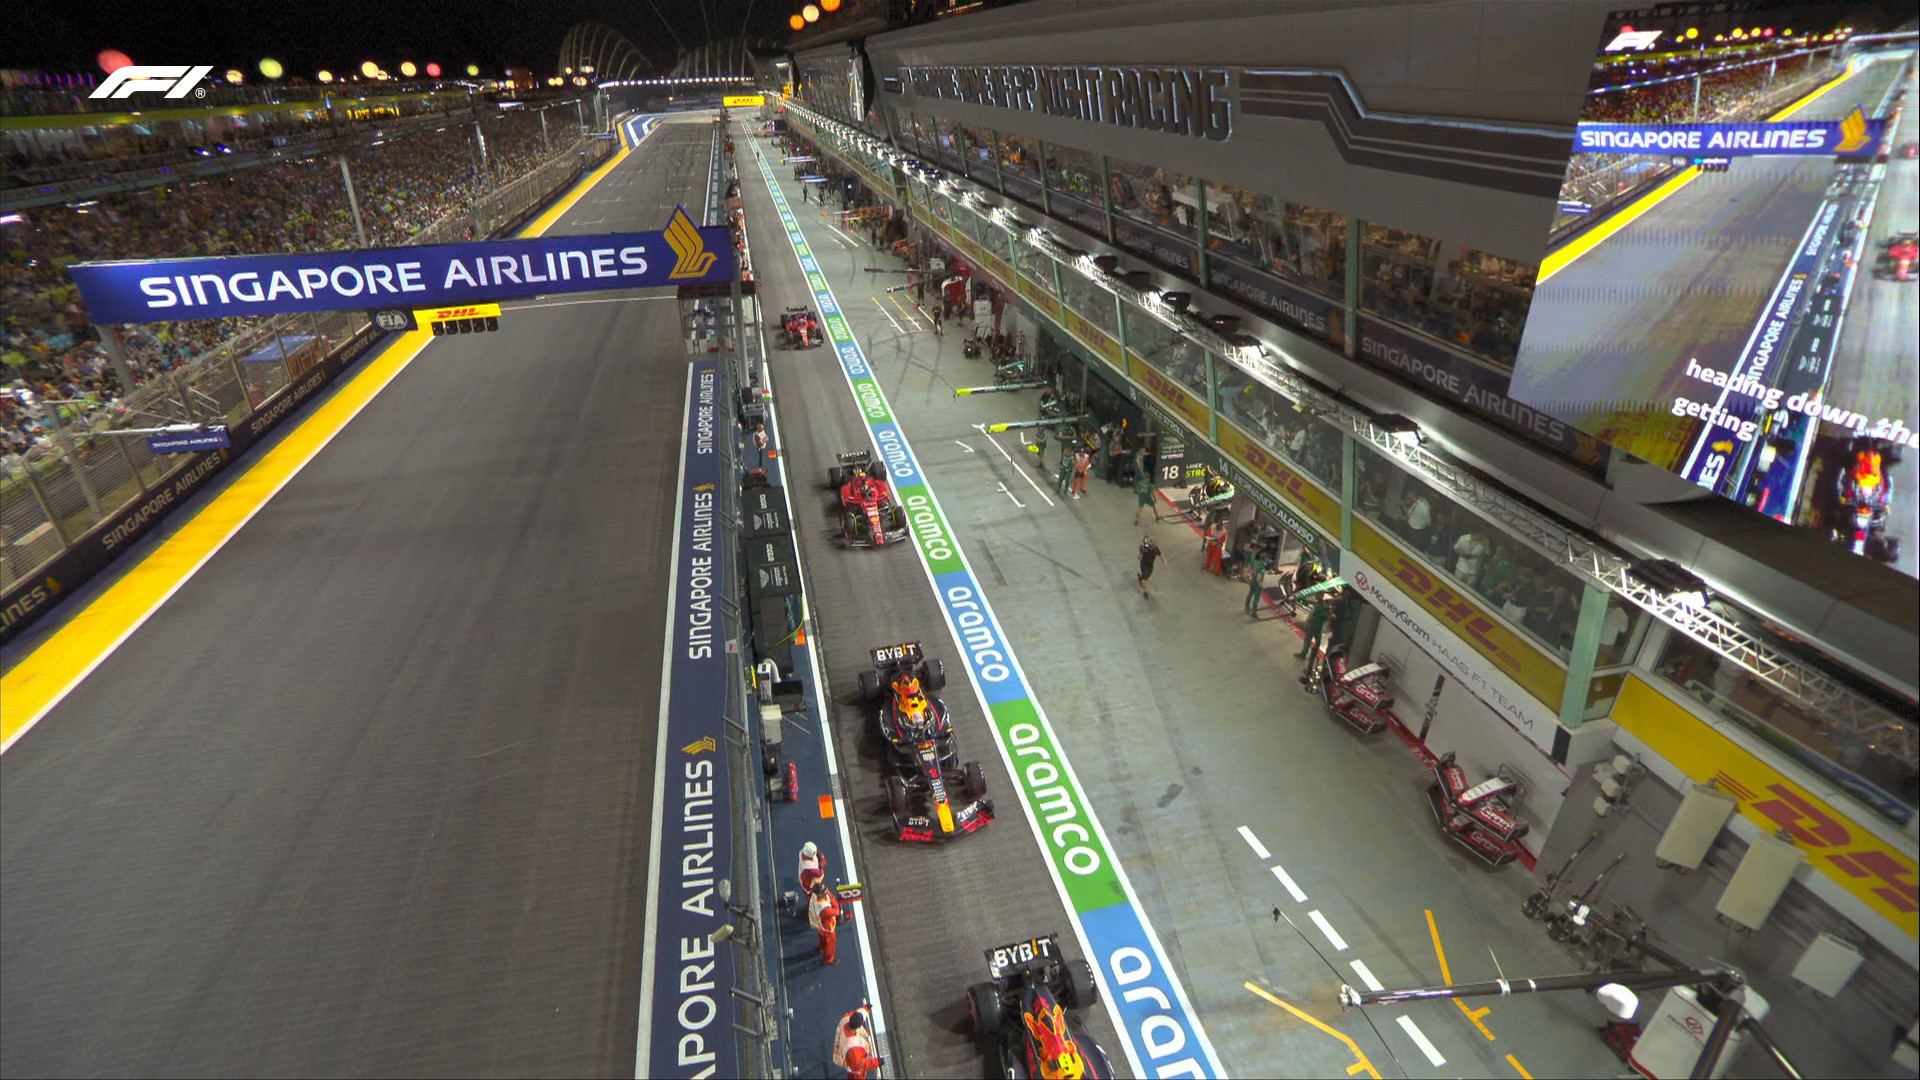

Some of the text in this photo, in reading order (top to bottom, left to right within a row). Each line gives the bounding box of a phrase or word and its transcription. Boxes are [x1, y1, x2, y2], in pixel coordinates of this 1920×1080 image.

[1107, 66, 1233, 143] RACING
[1581, 129, 1827, 149] SINGAPORE AIRLINES
[140, 247, 649, 308] SINGAPORE AIRLINES
[436, 308, 480, 319] DHL
[1270, 296, 1326, 331] AIRLINES
[251, 396, 293, 434] SINGAPORE
[1146, 370, 1189, 413] DHL
[1362, 336, 1565, 442] SINGAPORE AIRLINES
[1671, 397, 1759, 442] getting
[1686, 358, 1784, 410] heading
[1786, 392, 1868, 431] down
[878, 430, 914, 477] aramco
[1162, 465, 1179, 479] 18
[1244, 443, 1307, 504] DHL
[102, 451, 220, 550] SINGAPORE AIRLINES
[906, 495, 952, 560] aramco
[1234, 473, 1314, 544] FERNANDO ALONSO
[688, 492, 713, 660] SINGAPORE AIRLINES
[1396, 558, 1497, 651] DHL
[0, 586, 46, 632] INES
[947, 586, 1010, 682] aramco
[877, 643, 916, 661] BYBIT
[1370, 586, 1431, 642] MoneyGram
[1431, 639, 1469, 675] HAAS
[1471, 673, 1487, 689] F1
[1490, 688, 1536, 730] TEAM
[1008, 723, 1100, 875] aramco
[682, 759, 714, 917] AIRLINES
[900, 826, 934, 842] Red
[994, 938, 1051, 968] BYBIT
